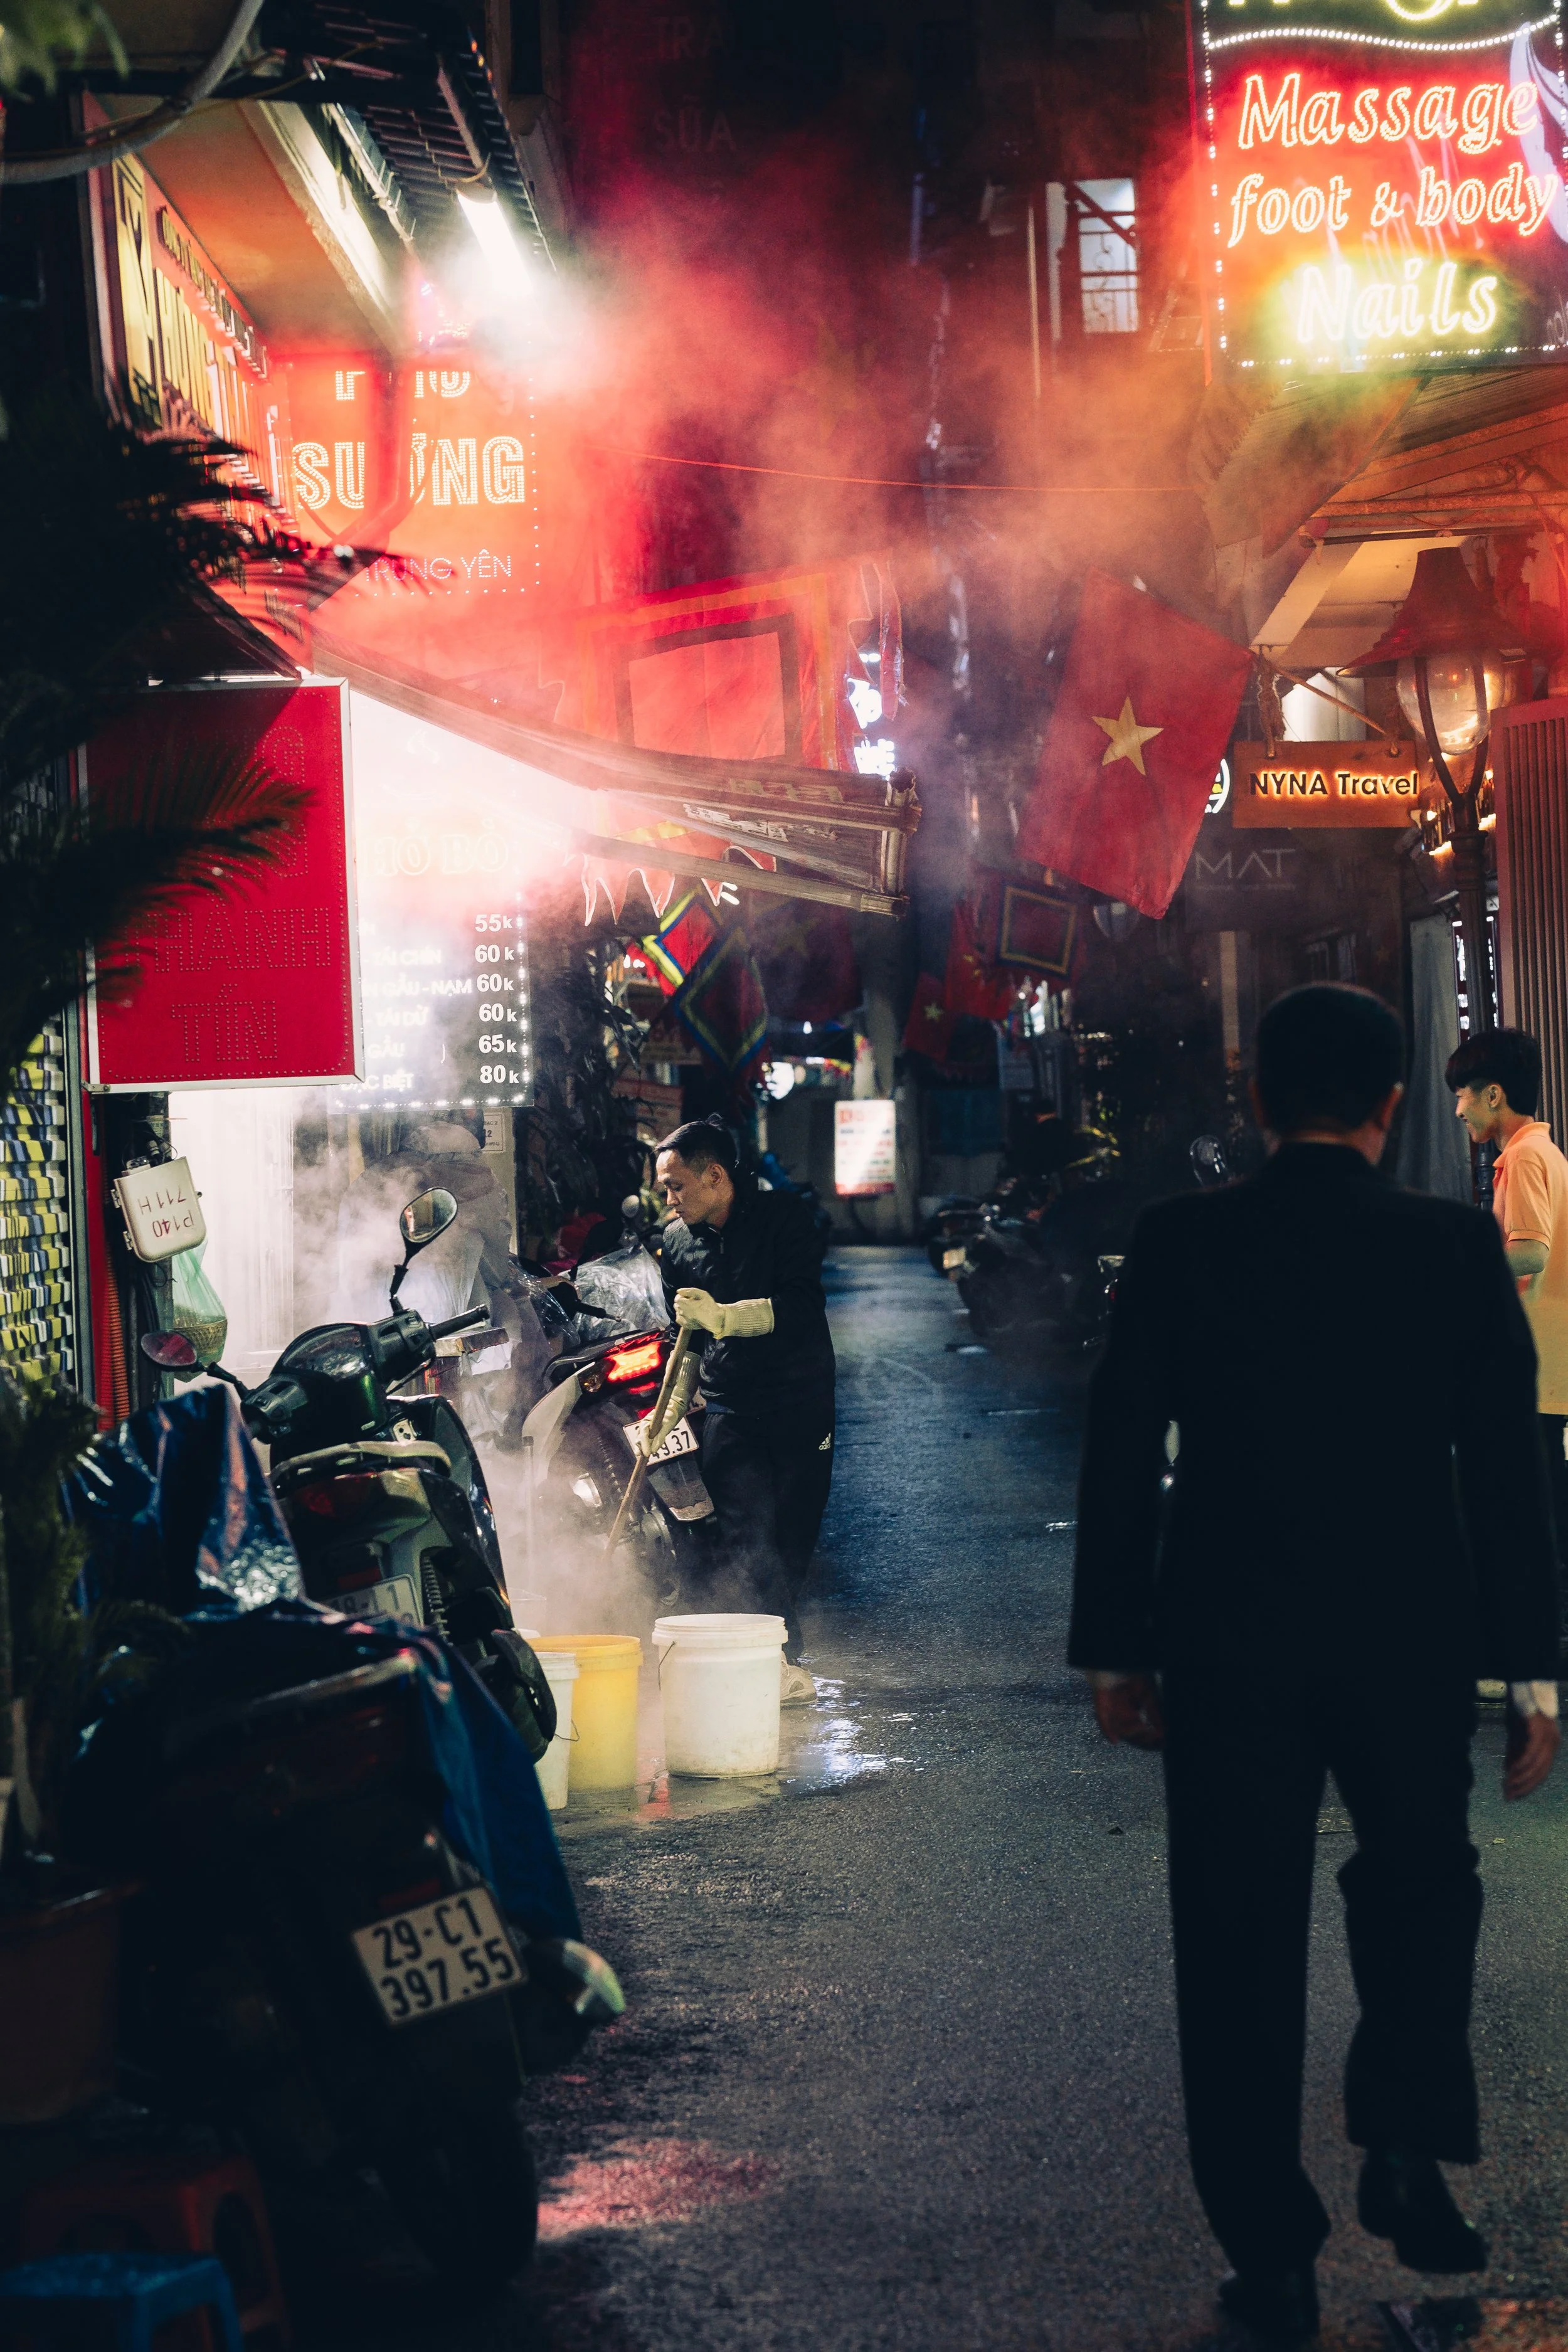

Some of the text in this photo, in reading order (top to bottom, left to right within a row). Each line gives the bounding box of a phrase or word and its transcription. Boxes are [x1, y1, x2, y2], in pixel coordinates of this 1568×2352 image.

[1237, 72, 1539, 154] Massage
[1227, 162, 1560, 248] foot & body
[1296, 257, 1498, 344] Nails
[460, 548, 512, 579] YÊN
[1249, 770, 1419, 796] NYNA Travel
[171, 982, 280, 1062] TÍN
[379, 1939, 514, 2017] 397.55
